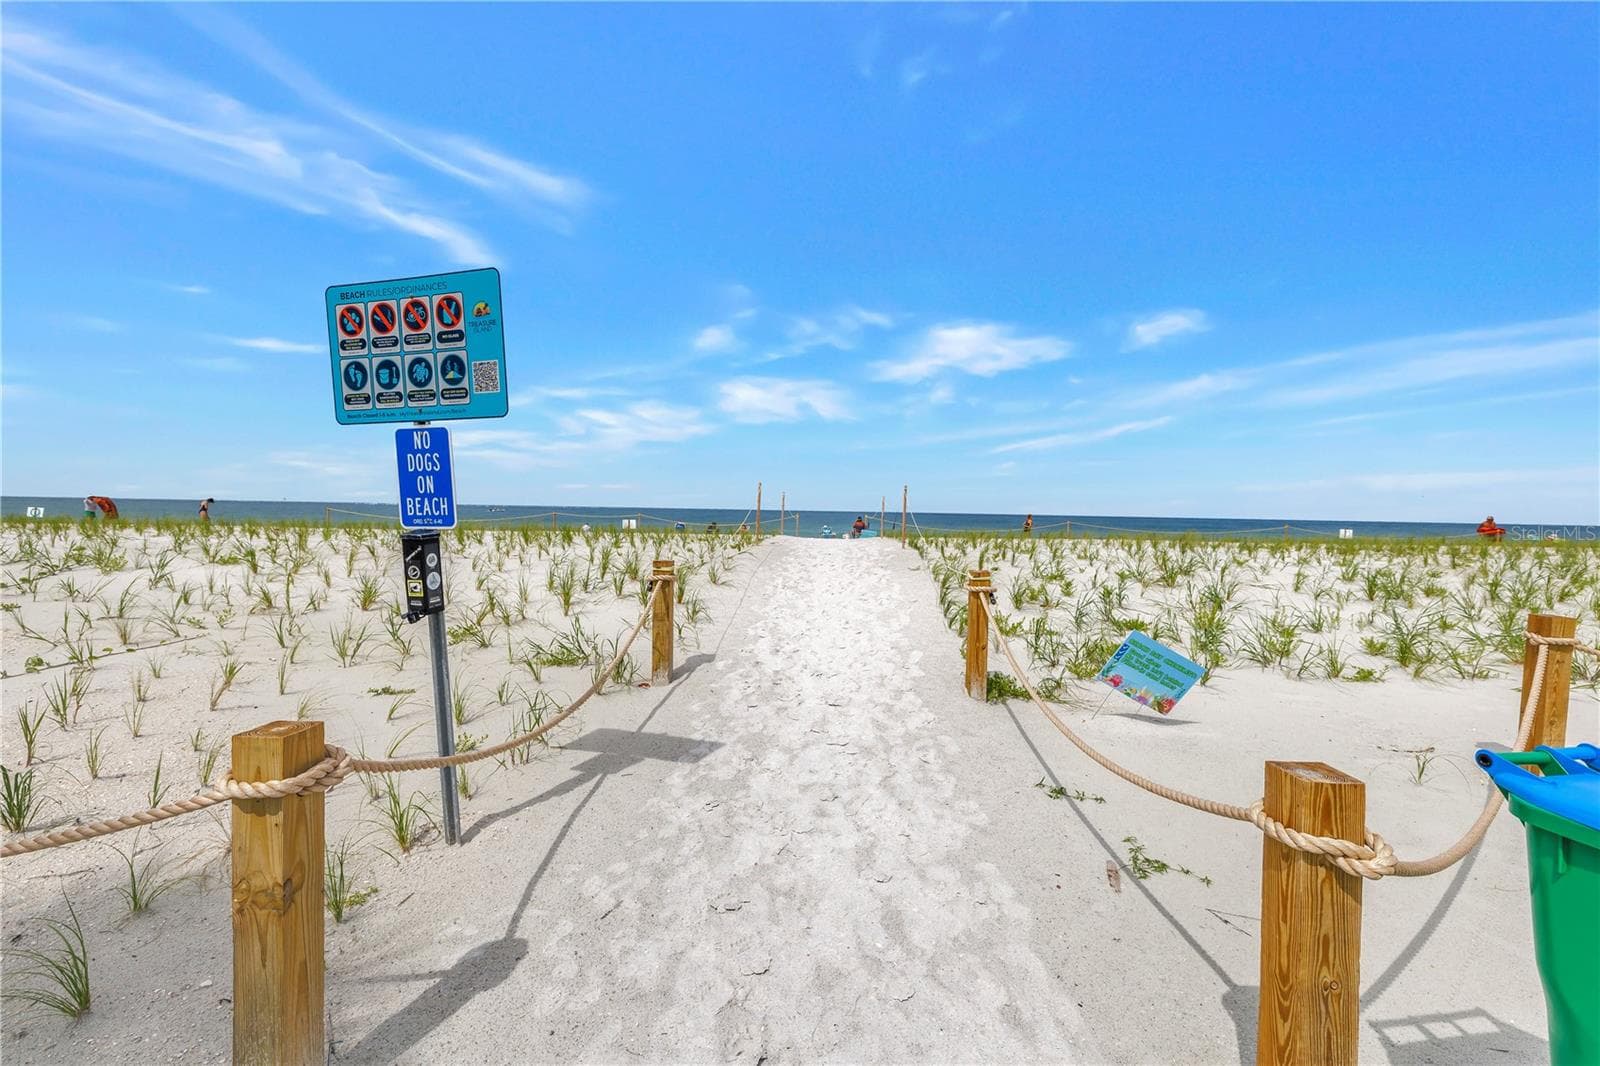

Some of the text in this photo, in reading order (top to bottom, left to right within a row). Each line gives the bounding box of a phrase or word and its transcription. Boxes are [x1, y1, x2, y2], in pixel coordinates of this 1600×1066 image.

[340, 281, 448, 300] BEACH RULES/ORDINANCES
[468, 319, 497, 327] TREASURE
[413, 430, 430, 450] NO
[407, 453, 440, 472] DOGS
[417, 475, 434, 494] ON
[406, 497, 448, 516] BEACH
